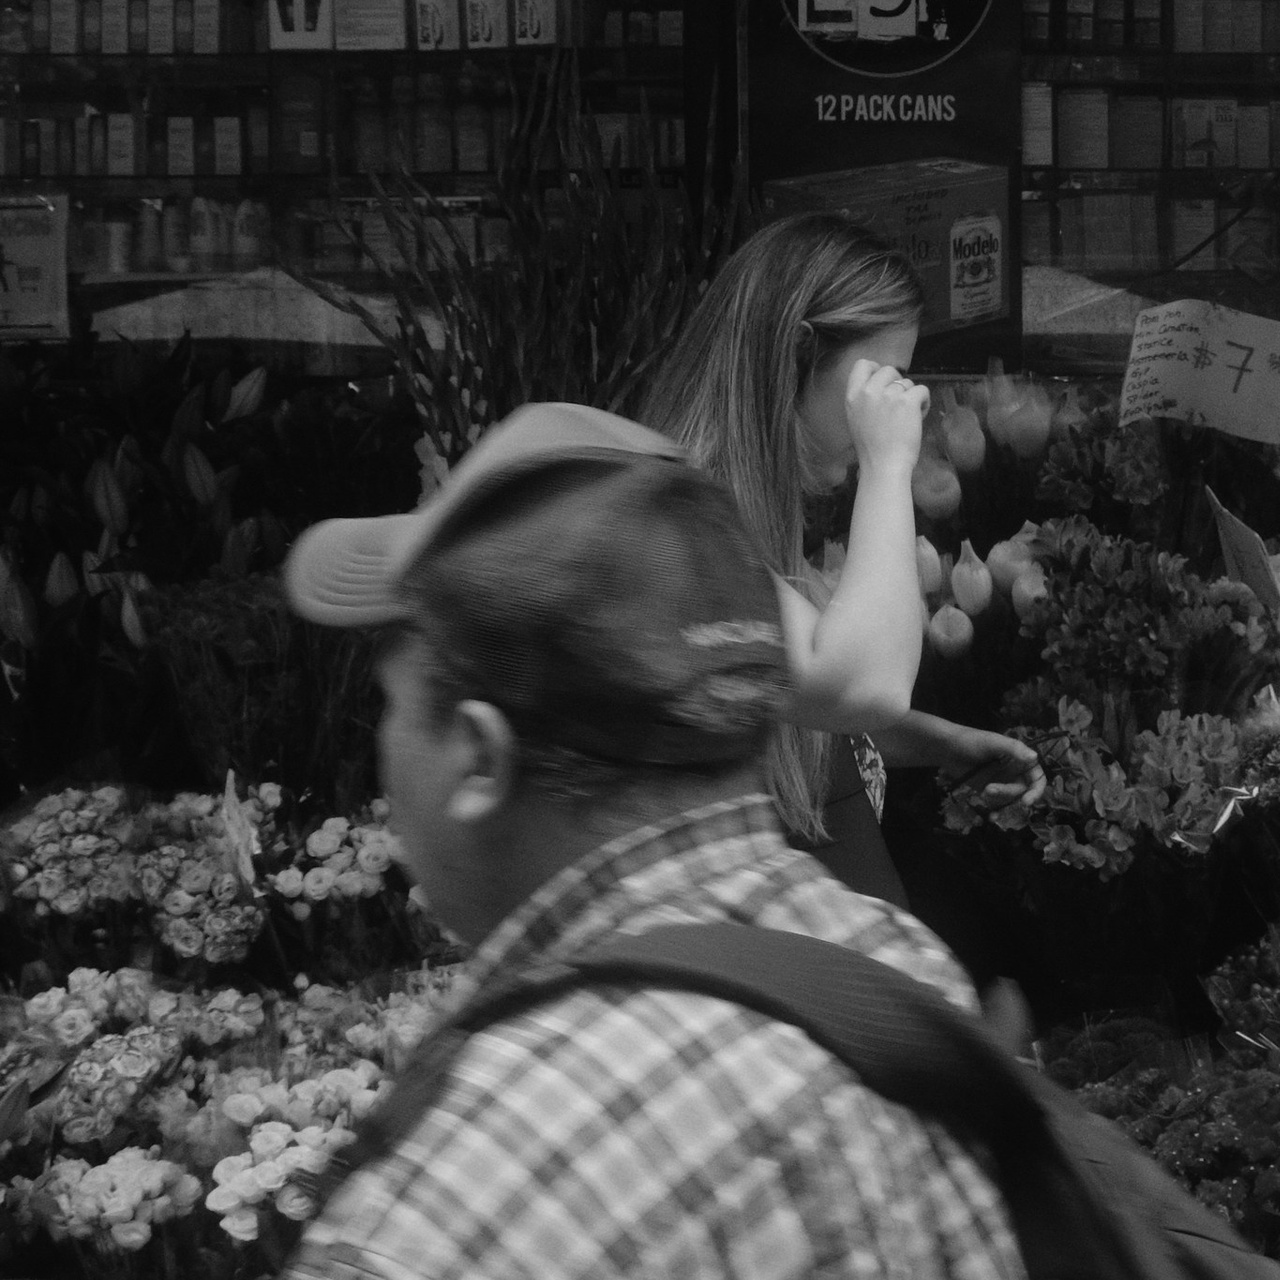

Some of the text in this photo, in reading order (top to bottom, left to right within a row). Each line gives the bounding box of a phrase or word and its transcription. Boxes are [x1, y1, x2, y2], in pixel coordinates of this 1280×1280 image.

[815, 94, 956, 121] 12 PACK CANS
[952, 233, 999, 260] Modelo
